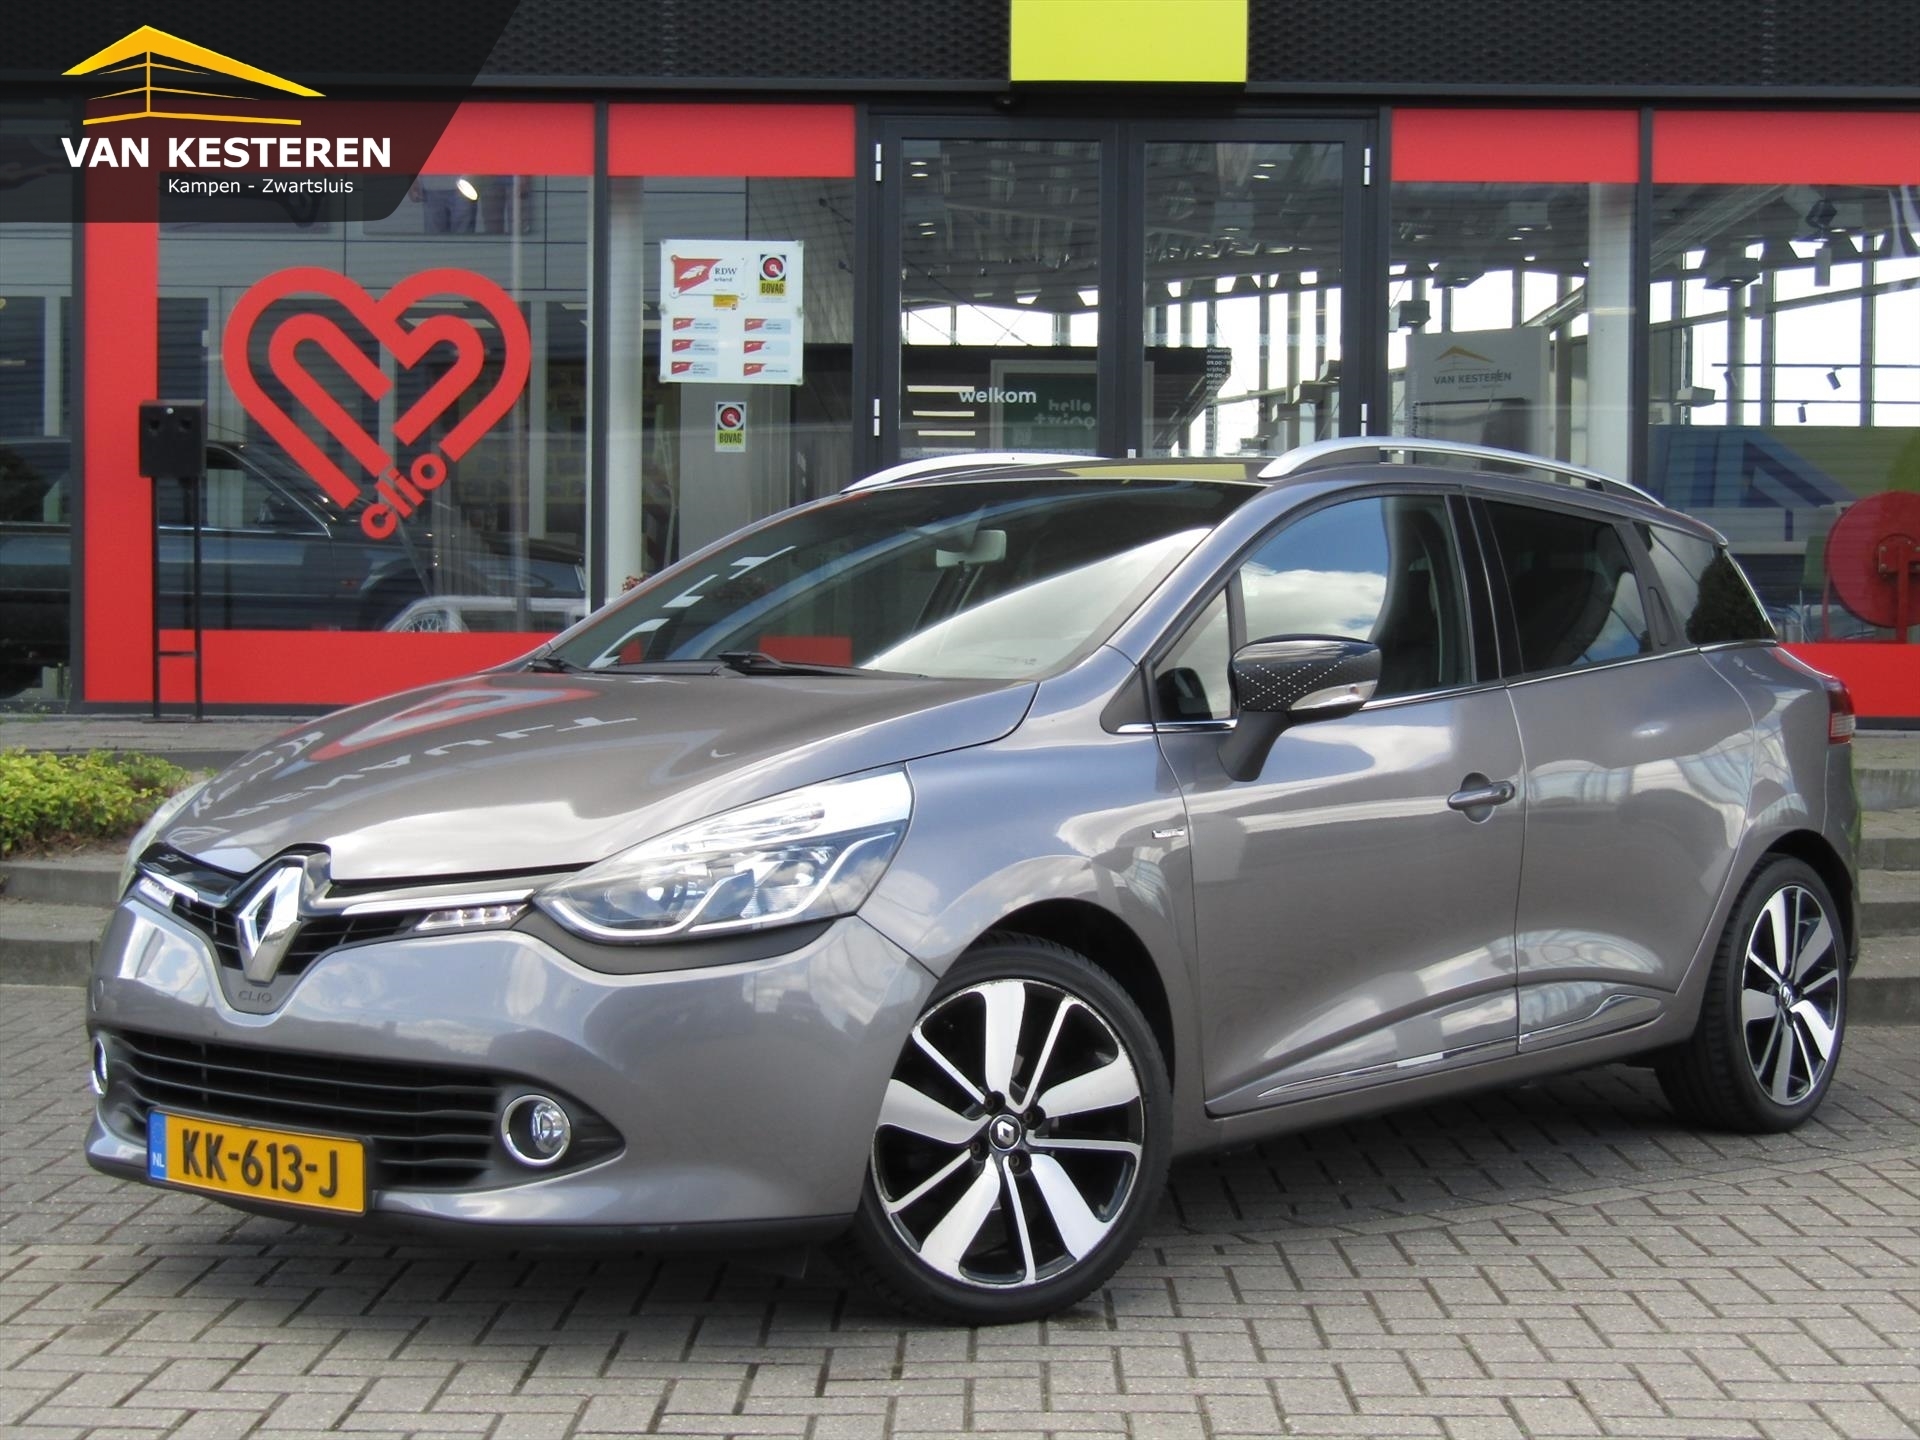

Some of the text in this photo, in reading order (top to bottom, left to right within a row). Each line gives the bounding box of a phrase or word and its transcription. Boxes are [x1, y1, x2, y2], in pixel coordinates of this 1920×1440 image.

[714, 267, 738, 275] RDW
[761, 282, 784, 294] BOVAG
[1433, 371, 1512, 385] VAN KESTEREN
[959, 387, 1037, 403] welkom
[1049, 400, 1092, 412] hello
[719, 432, 742, 444] BOVAG
[361, 453, 447, 539] clio
[238, 990, 272, 1002] CLIO
[152, 1152, 165, 1168] NL
[182, 1128, 338, 1198] KK-613-J
